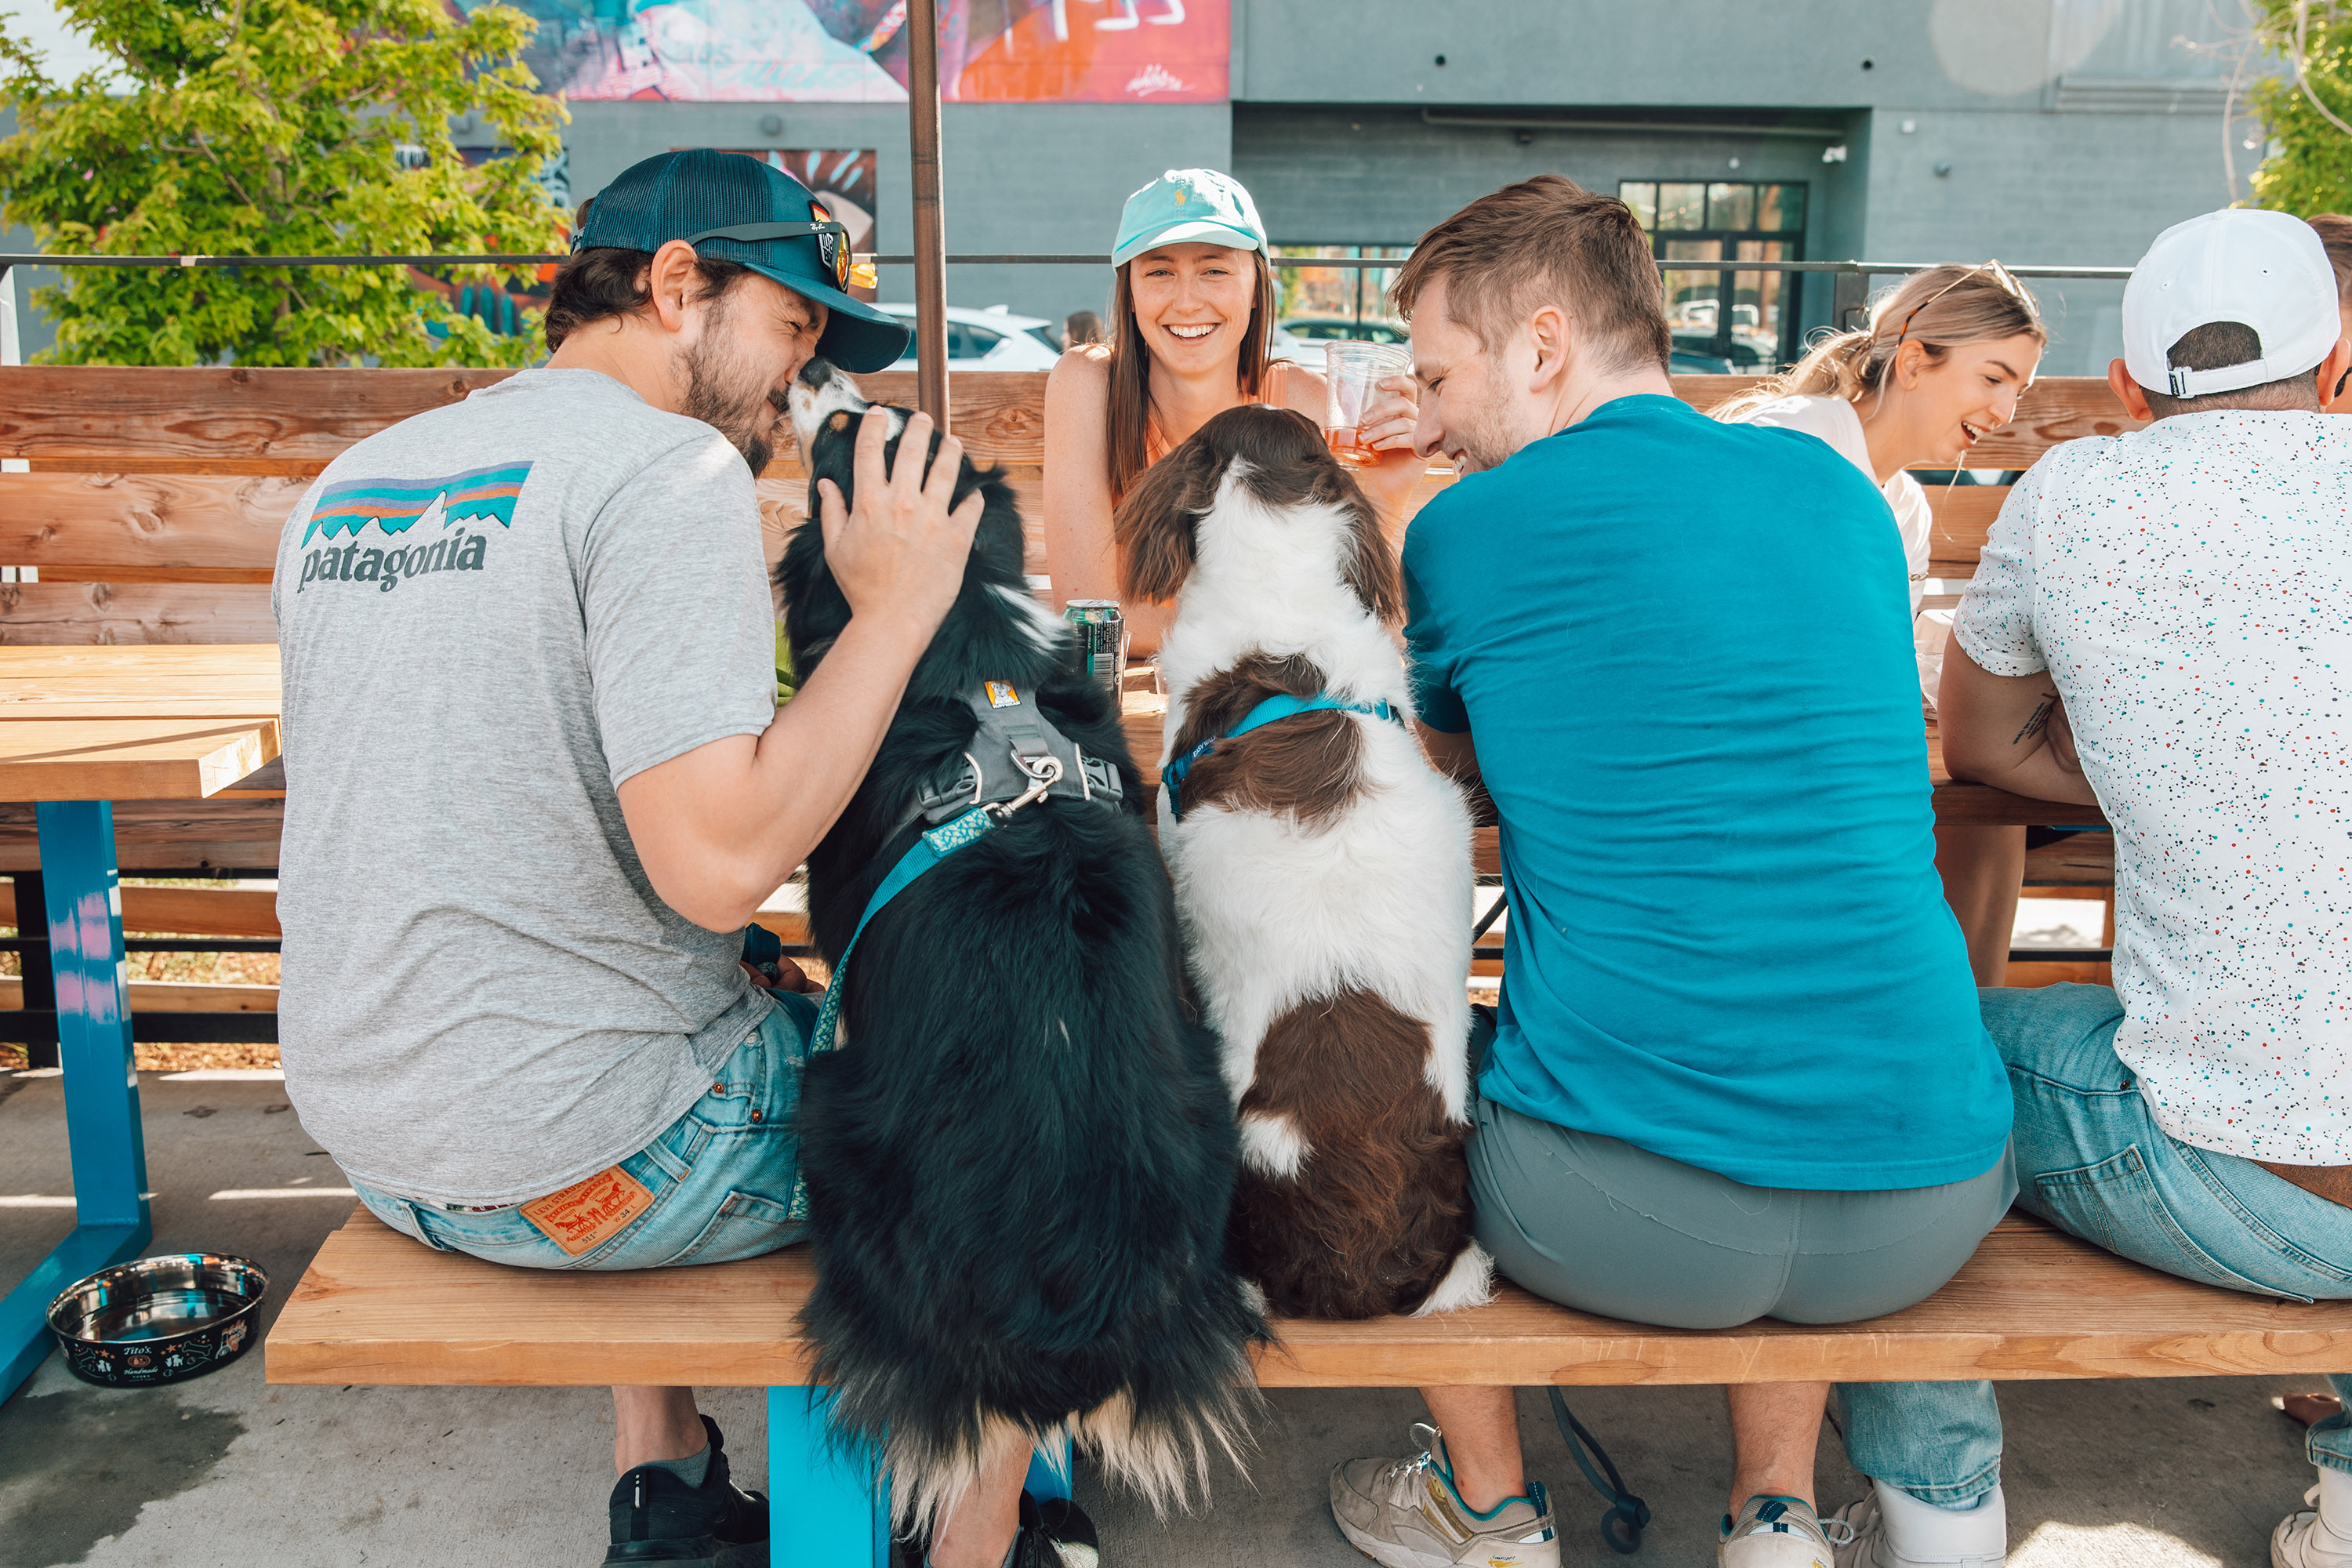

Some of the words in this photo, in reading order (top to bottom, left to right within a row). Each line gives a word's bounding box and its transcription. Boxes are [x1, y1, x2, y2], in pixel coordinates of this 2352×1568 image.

[297, 527, 488, 593] patagonia
[1192, 742, 1203, 757] EASY
[590, 1185, 608, 1200] CLOTHING
[533, 1203, 554, 1216] LEVI
[620, 1208, 630, 1218] 34
[124, 1346, 151, 1355] Tito's
[124, 1366, 158, 1375] Handmade
